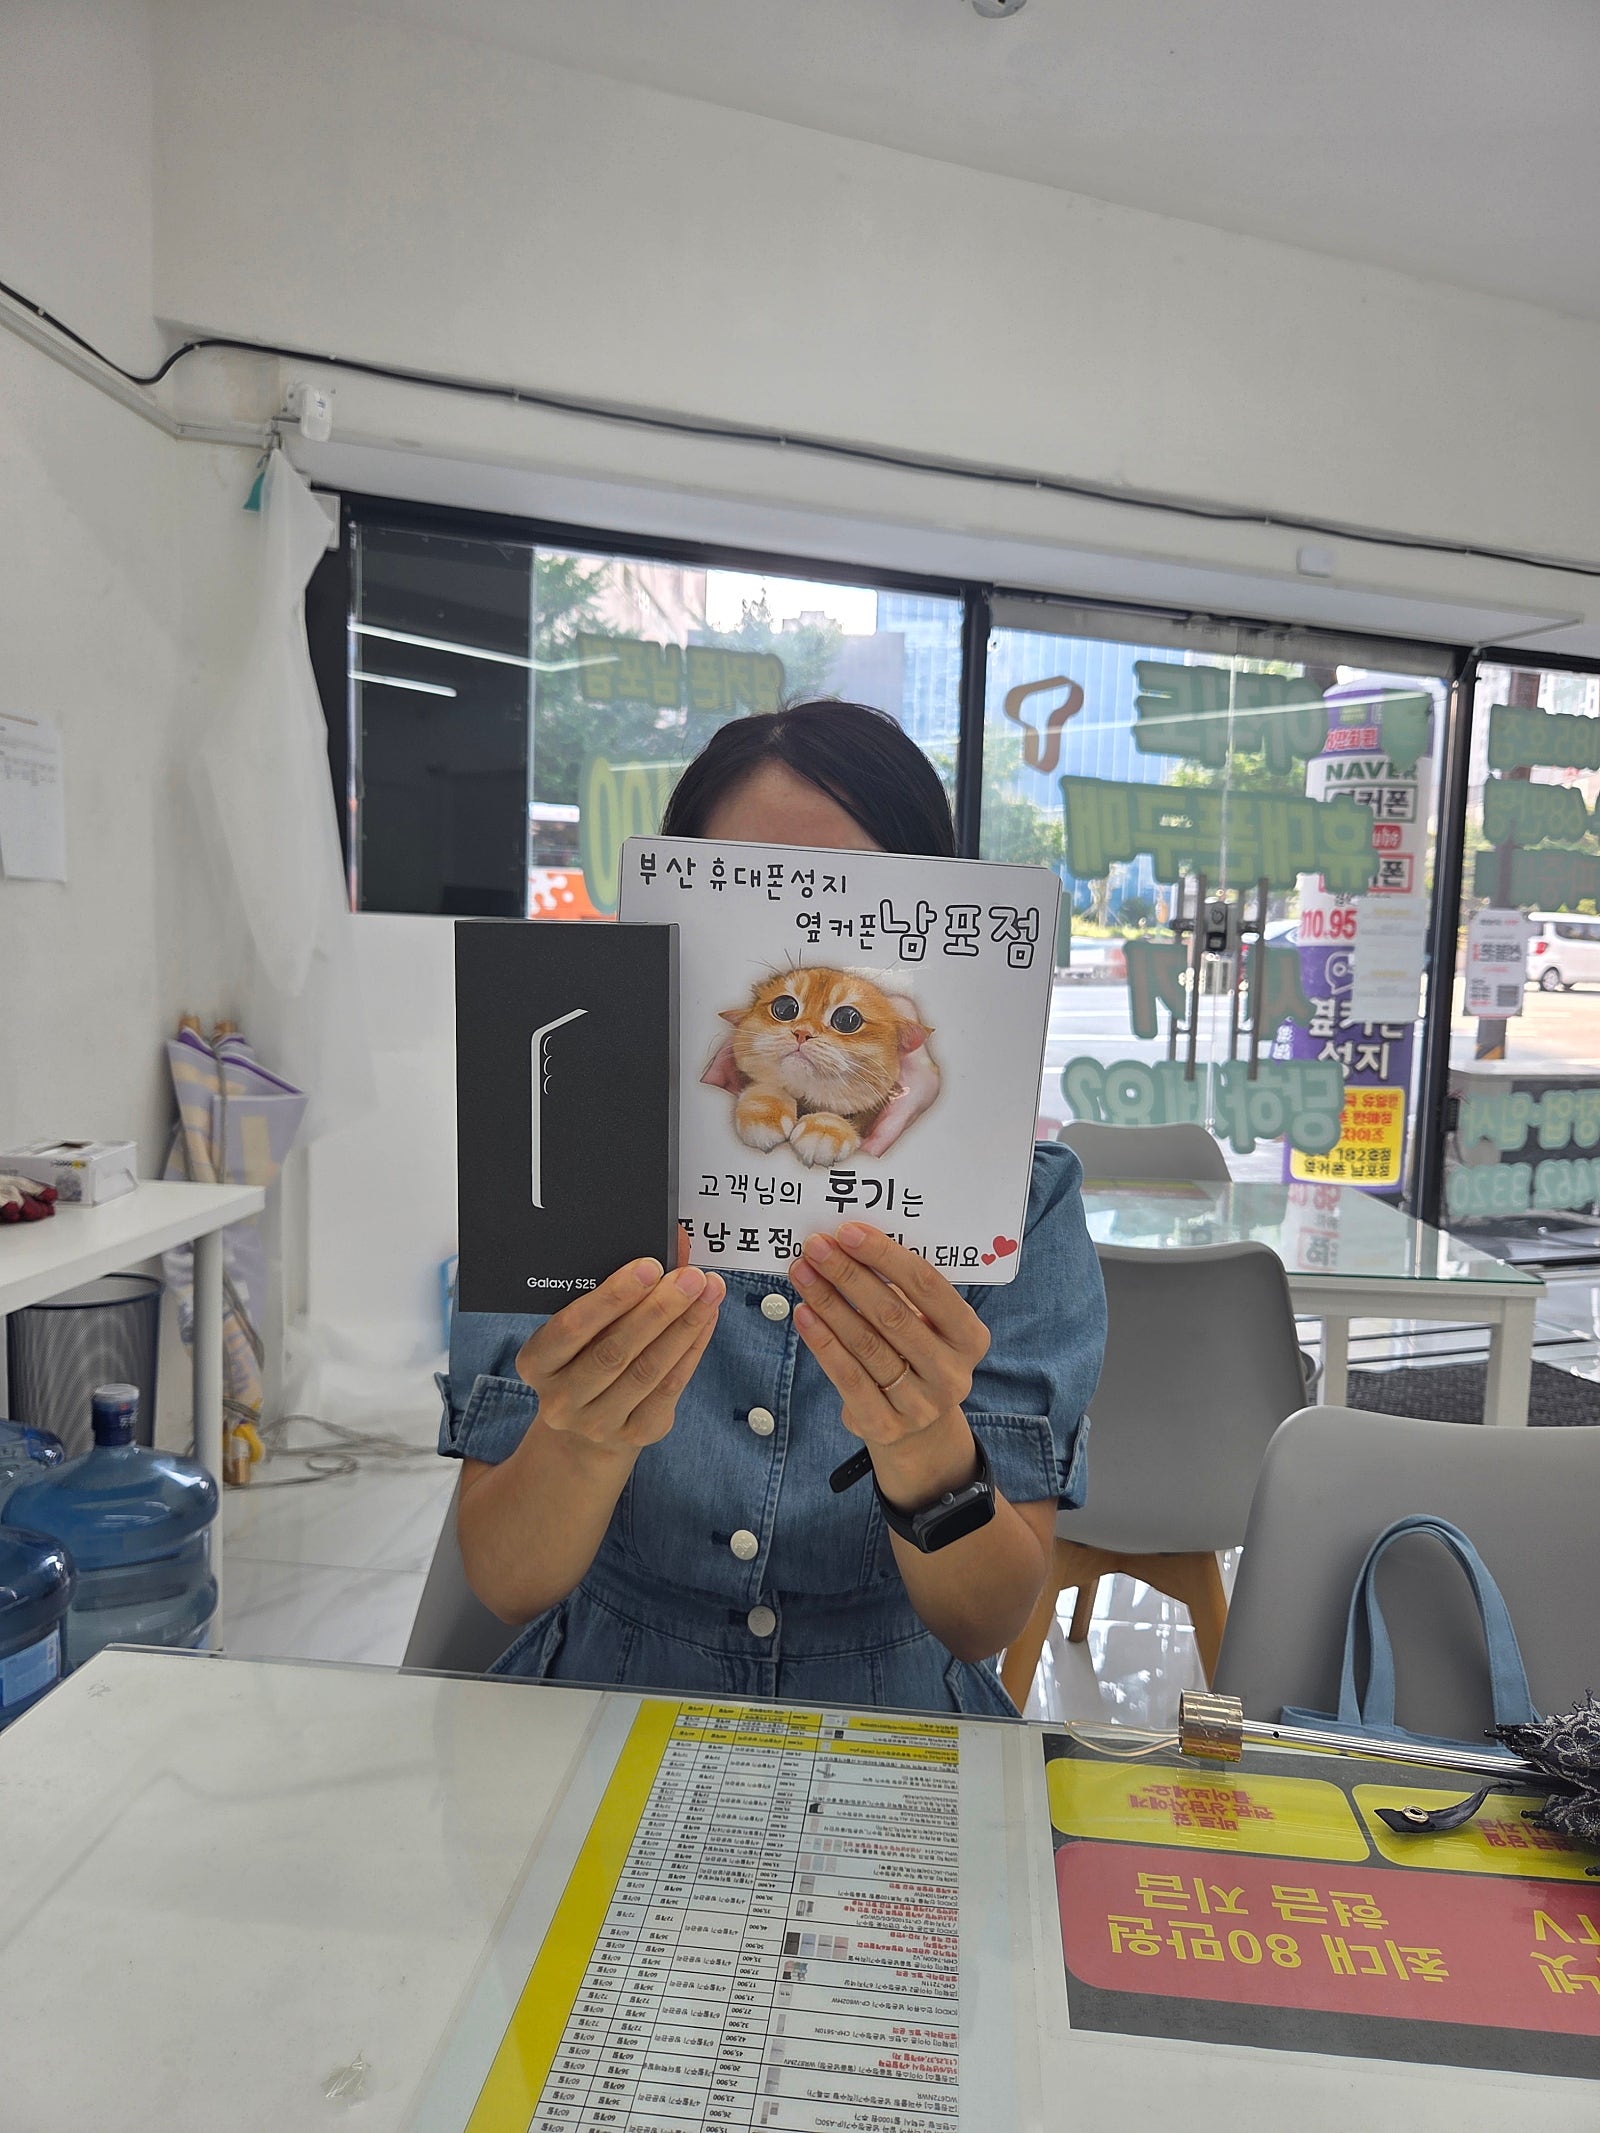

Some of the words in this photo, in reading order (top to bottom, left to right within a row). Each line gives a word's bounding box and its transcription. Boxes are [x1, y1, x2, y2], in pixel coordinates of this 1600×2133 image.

[640, 853, 696, 889] 부산
[710, 860, 847, 900] 휴대폰성지
[796, 911, 877, 950] 옆커폰
[879, 899, 1040, 969] 남포점
[698, 1174, 802, 1205] 고객님의
[825, 1170, 924, 1217] 후기는
[934, 1245, 980, 1268] 돼요
[527, 1277, 573, 1292] Galaxy
[575, 1278, 597, 1290] S25
[1128, 1794, 1227, 1816] 상담사에게
[1483, 1832, 1529, 1850] 당일
[1134, 1872, 1249, 1915] 지급
[1270, 1884, 1389, 1930] 현금
[1106, 1914, 1302, 1968] 80만원
[1320, 1934, 1449, 1983] 최대
[739, 1967, 759, 1975] 37,900
[733, 1993, 755, 2002] 21,900
[731, 2006, 752, 2015] 27,900
[620, 2022, 642, 2032] 72개월
[728, 2020, 749, 2029] 32,900
[616, 2037, 638, 2046] 60개월
[725, 2034, 746, 2043] 42,900
[568, 2046, 591, 2056] 60개월
[612, 2051, 634, 2061] 60개월
[722, 2049, 744, 2057] 45,900
[563, 2061, 585, 2071] 60개월
[607, 2065, 630, 2075] 36개월
[719, 2063, 741, 2072] 20,900
[557, 2076, 580, 2086] 60개월
[602, 2081, 625, 2091] 60개월
[716, 2079, 738, 2087] 25,900
[552, 2091, 575, 2101] 60개월
[598, 2096, 621, 2106] 36개월
[637, 2093, 666, 2103] 방문관리
[712, 2093, 735, 2102] 23,900
[546, 2106, 570, 2117] 60개월
[709, 2109, 732, 2118] 26,900
[593, 2112, 616, 2122] 60개월
